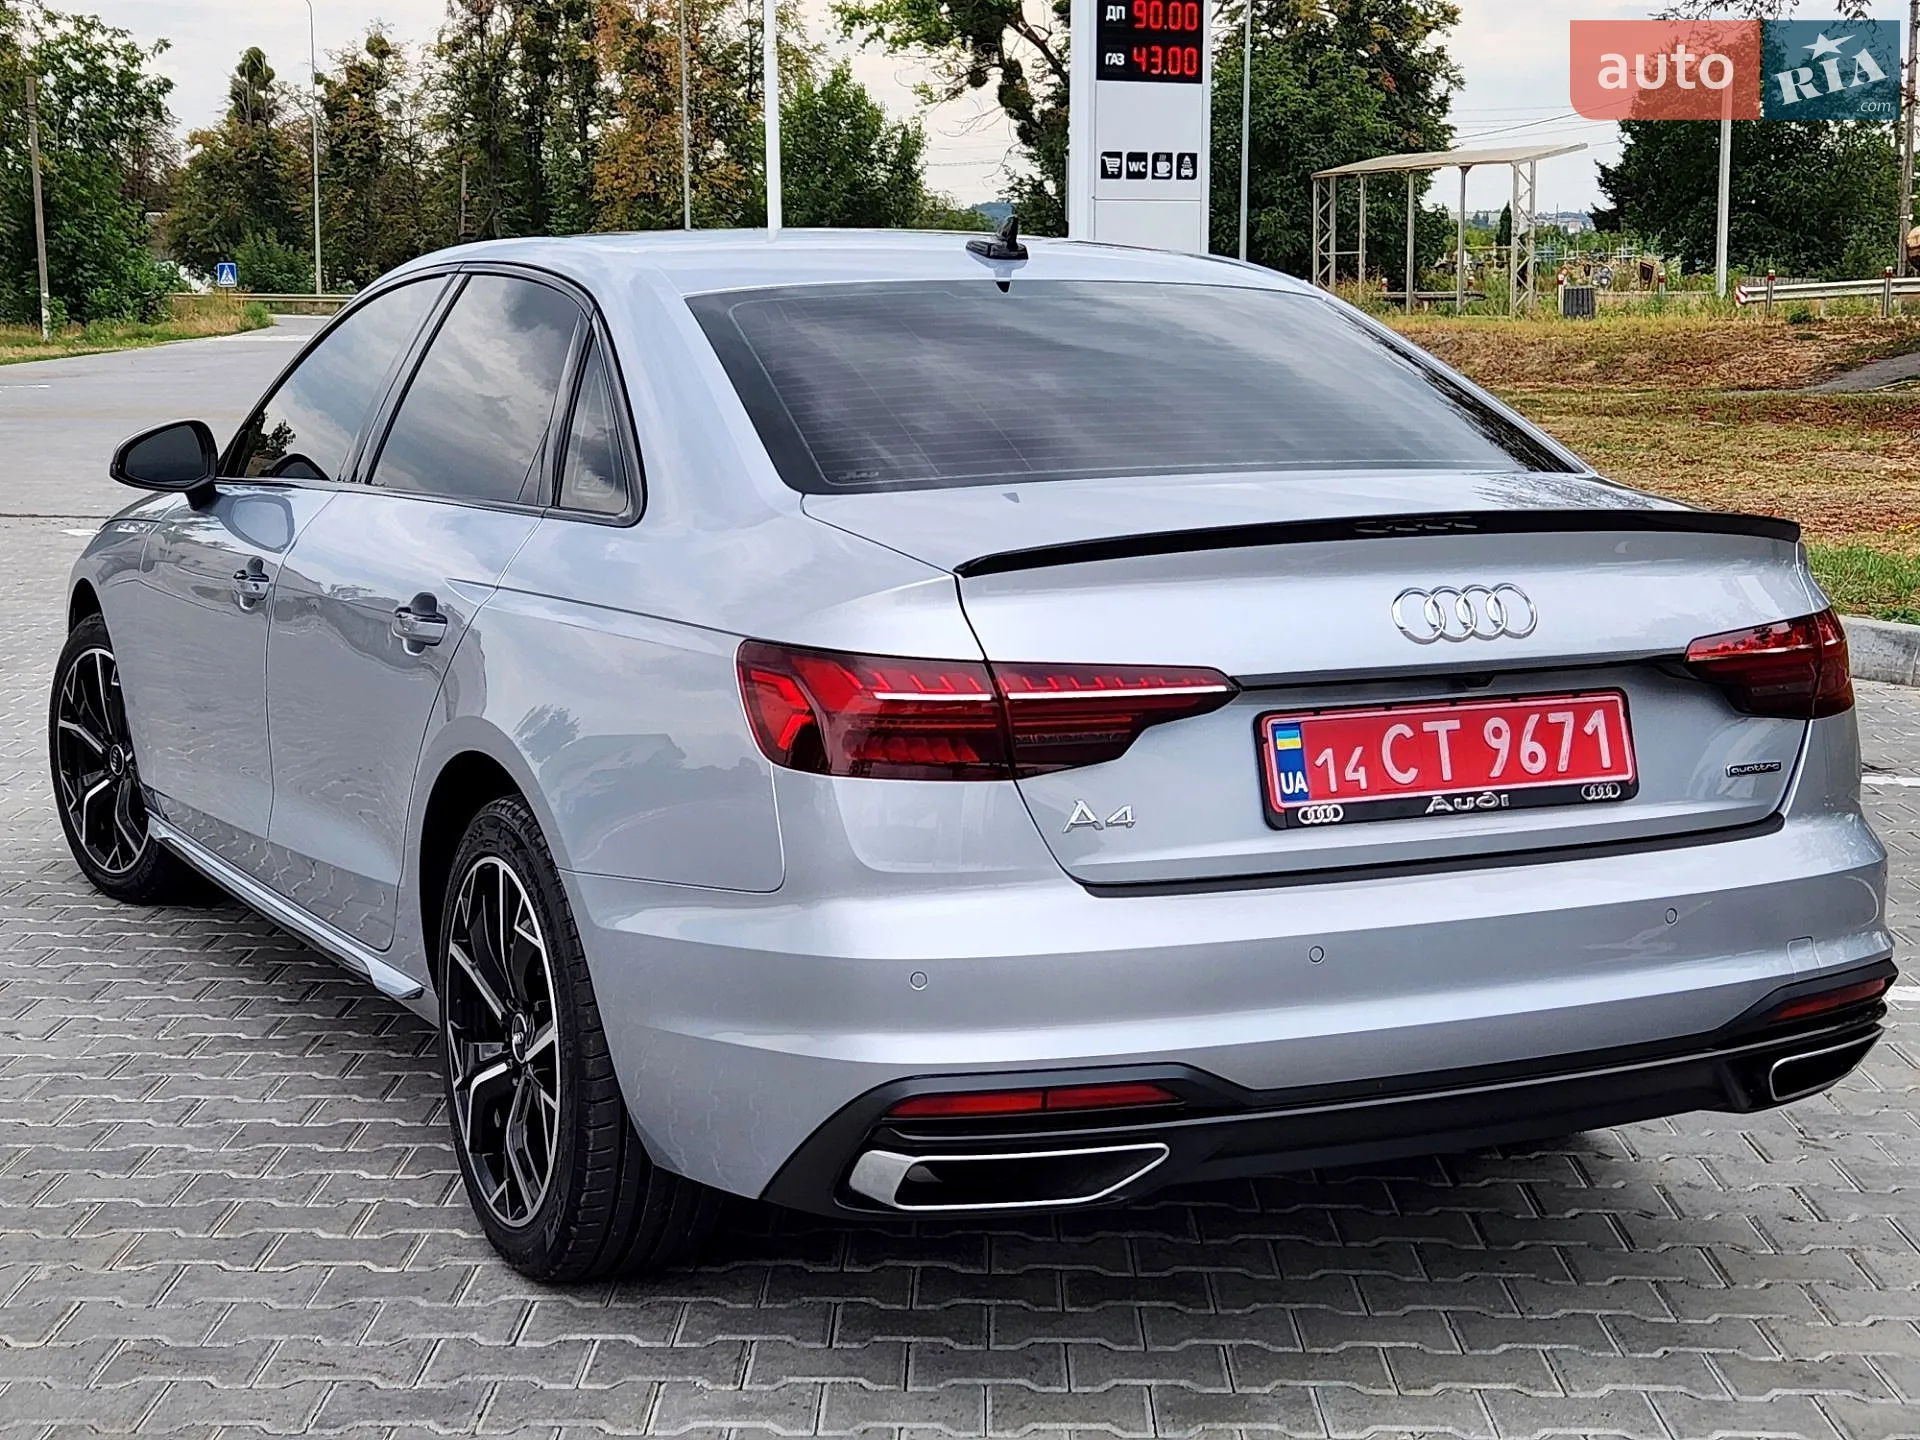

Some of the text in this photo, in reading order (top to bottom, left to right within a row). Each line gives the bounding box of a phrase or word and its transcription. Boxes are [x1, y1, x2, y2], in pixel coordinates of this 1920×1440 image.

[1105, 0, 1198, 31] ДП 90.00
[1105, 45, 1198, 76] ГАЗ 43.00
[1128, 161, 1147, 172] WC
[1314, 709, 1614, 793] 14 CT 9671
[1280, 771, 1308, 795] UA
[1730, 763, 1780, 775] quattro
[1063, 799, 1137, 834] A4
